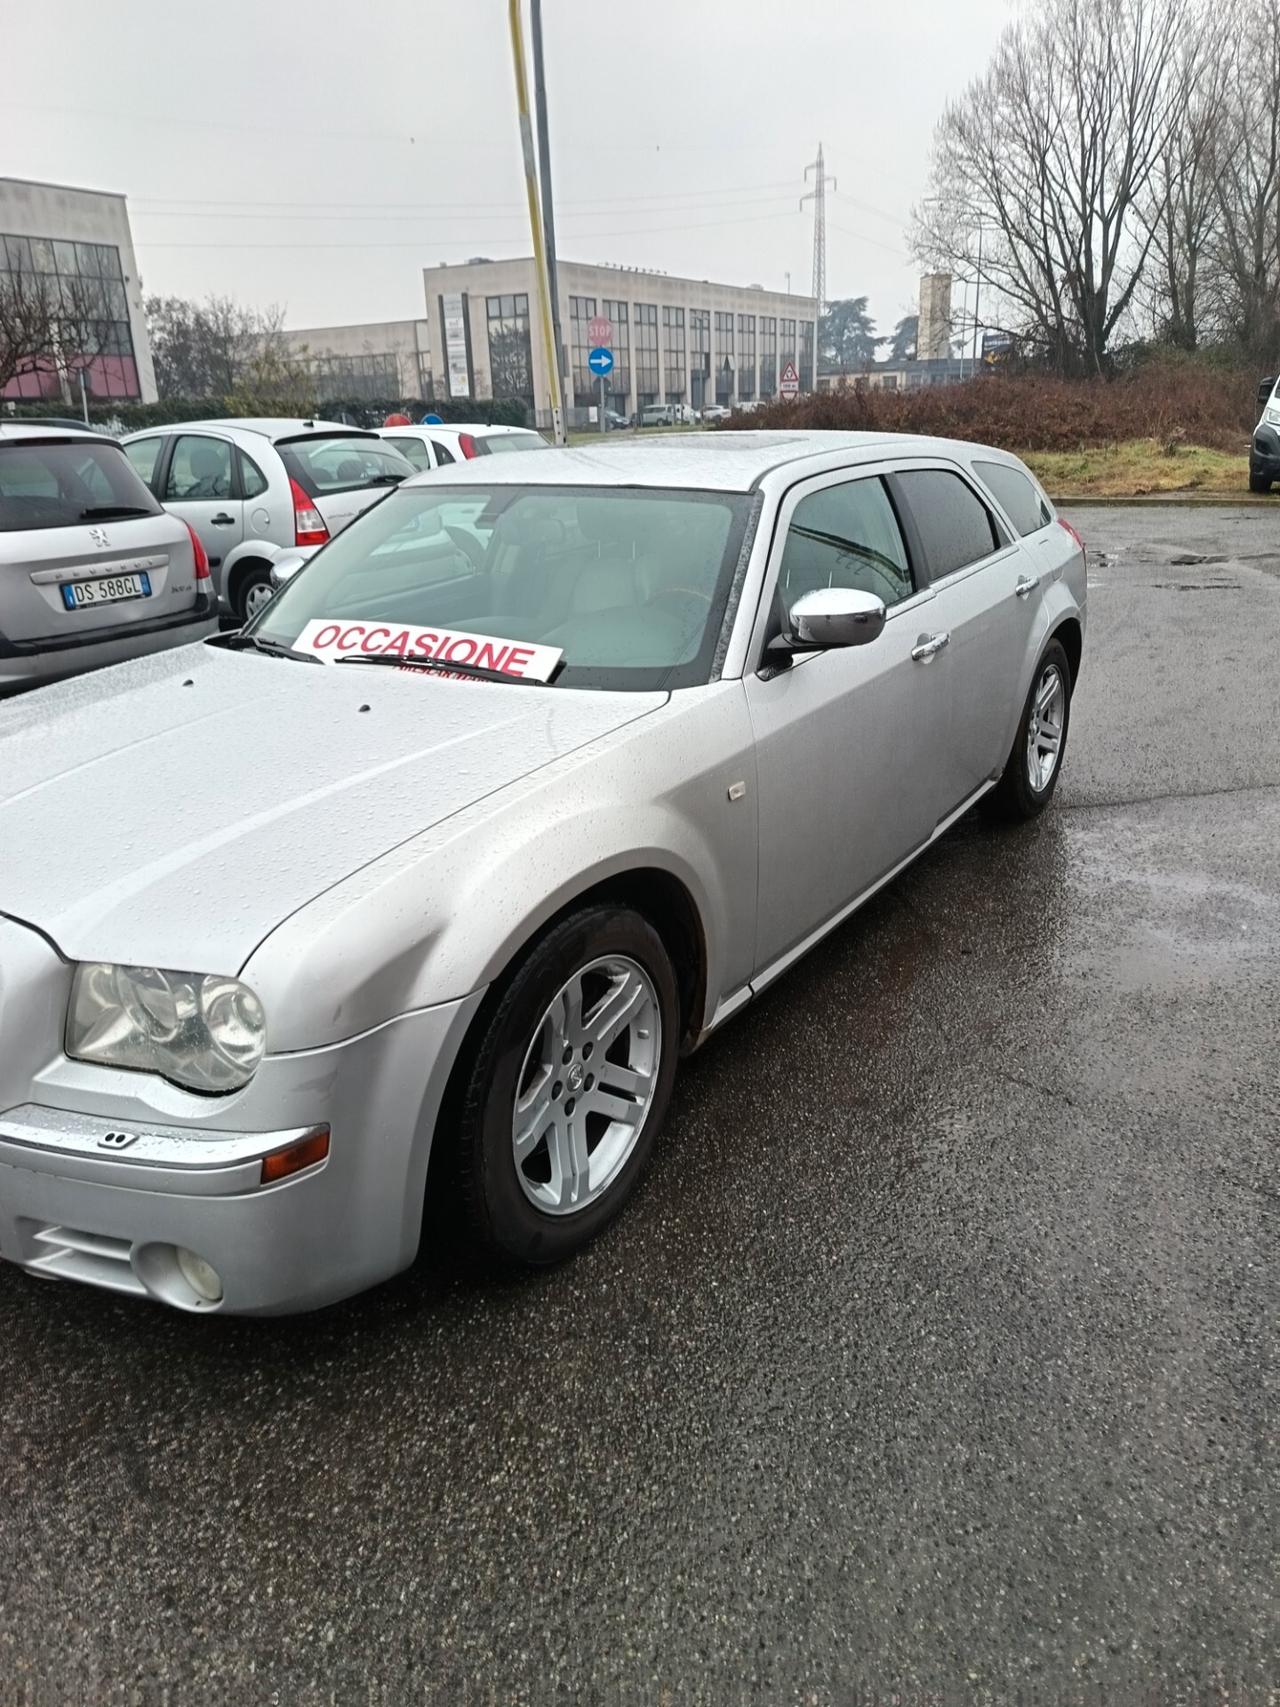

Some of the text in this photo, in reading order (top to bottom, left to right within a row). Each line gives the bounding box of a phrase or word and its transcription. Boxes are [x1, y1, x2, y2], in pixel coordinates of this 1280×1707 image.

[589, 325, 611, 337] STOP
[74, 584, 94, 603] DS
[99, 577, 141, 599] 588GL
[313, 625, 535, 677] OCCASIONE
